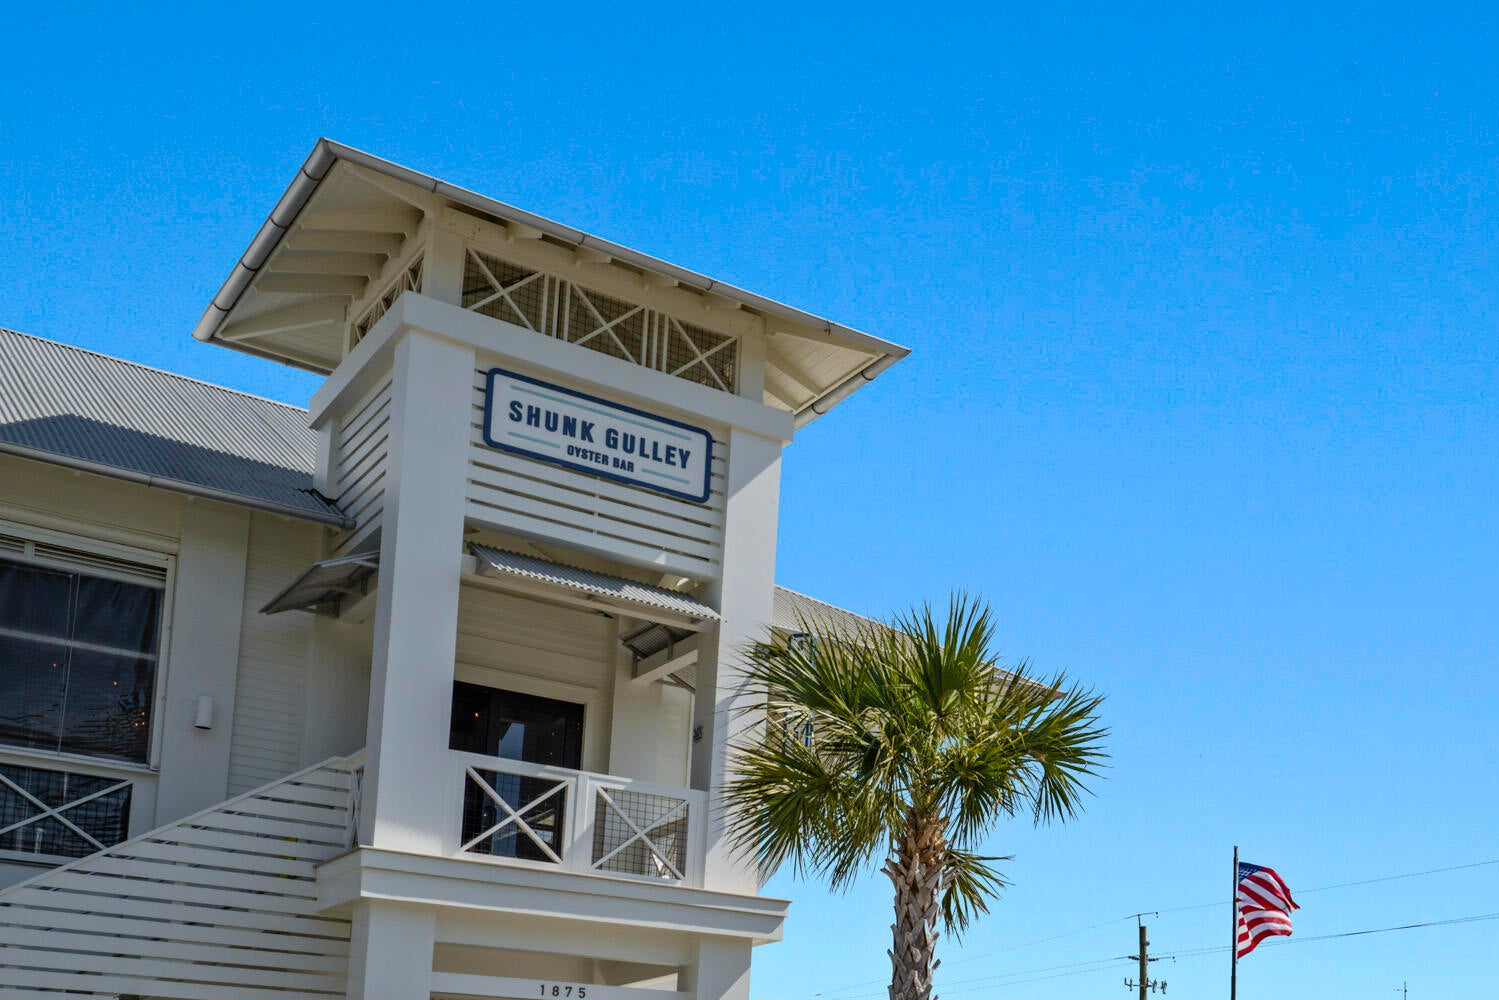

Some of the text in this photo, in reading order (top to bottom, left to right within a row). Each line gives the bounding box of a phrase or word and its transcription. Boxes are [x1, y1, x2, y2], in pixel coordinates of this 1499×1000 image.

[508, 400, 691, 469] SHUNK GULLEY
[567, 444, 635, 473] OYSTER BAR
[540, 984, 586, 999] 1875
